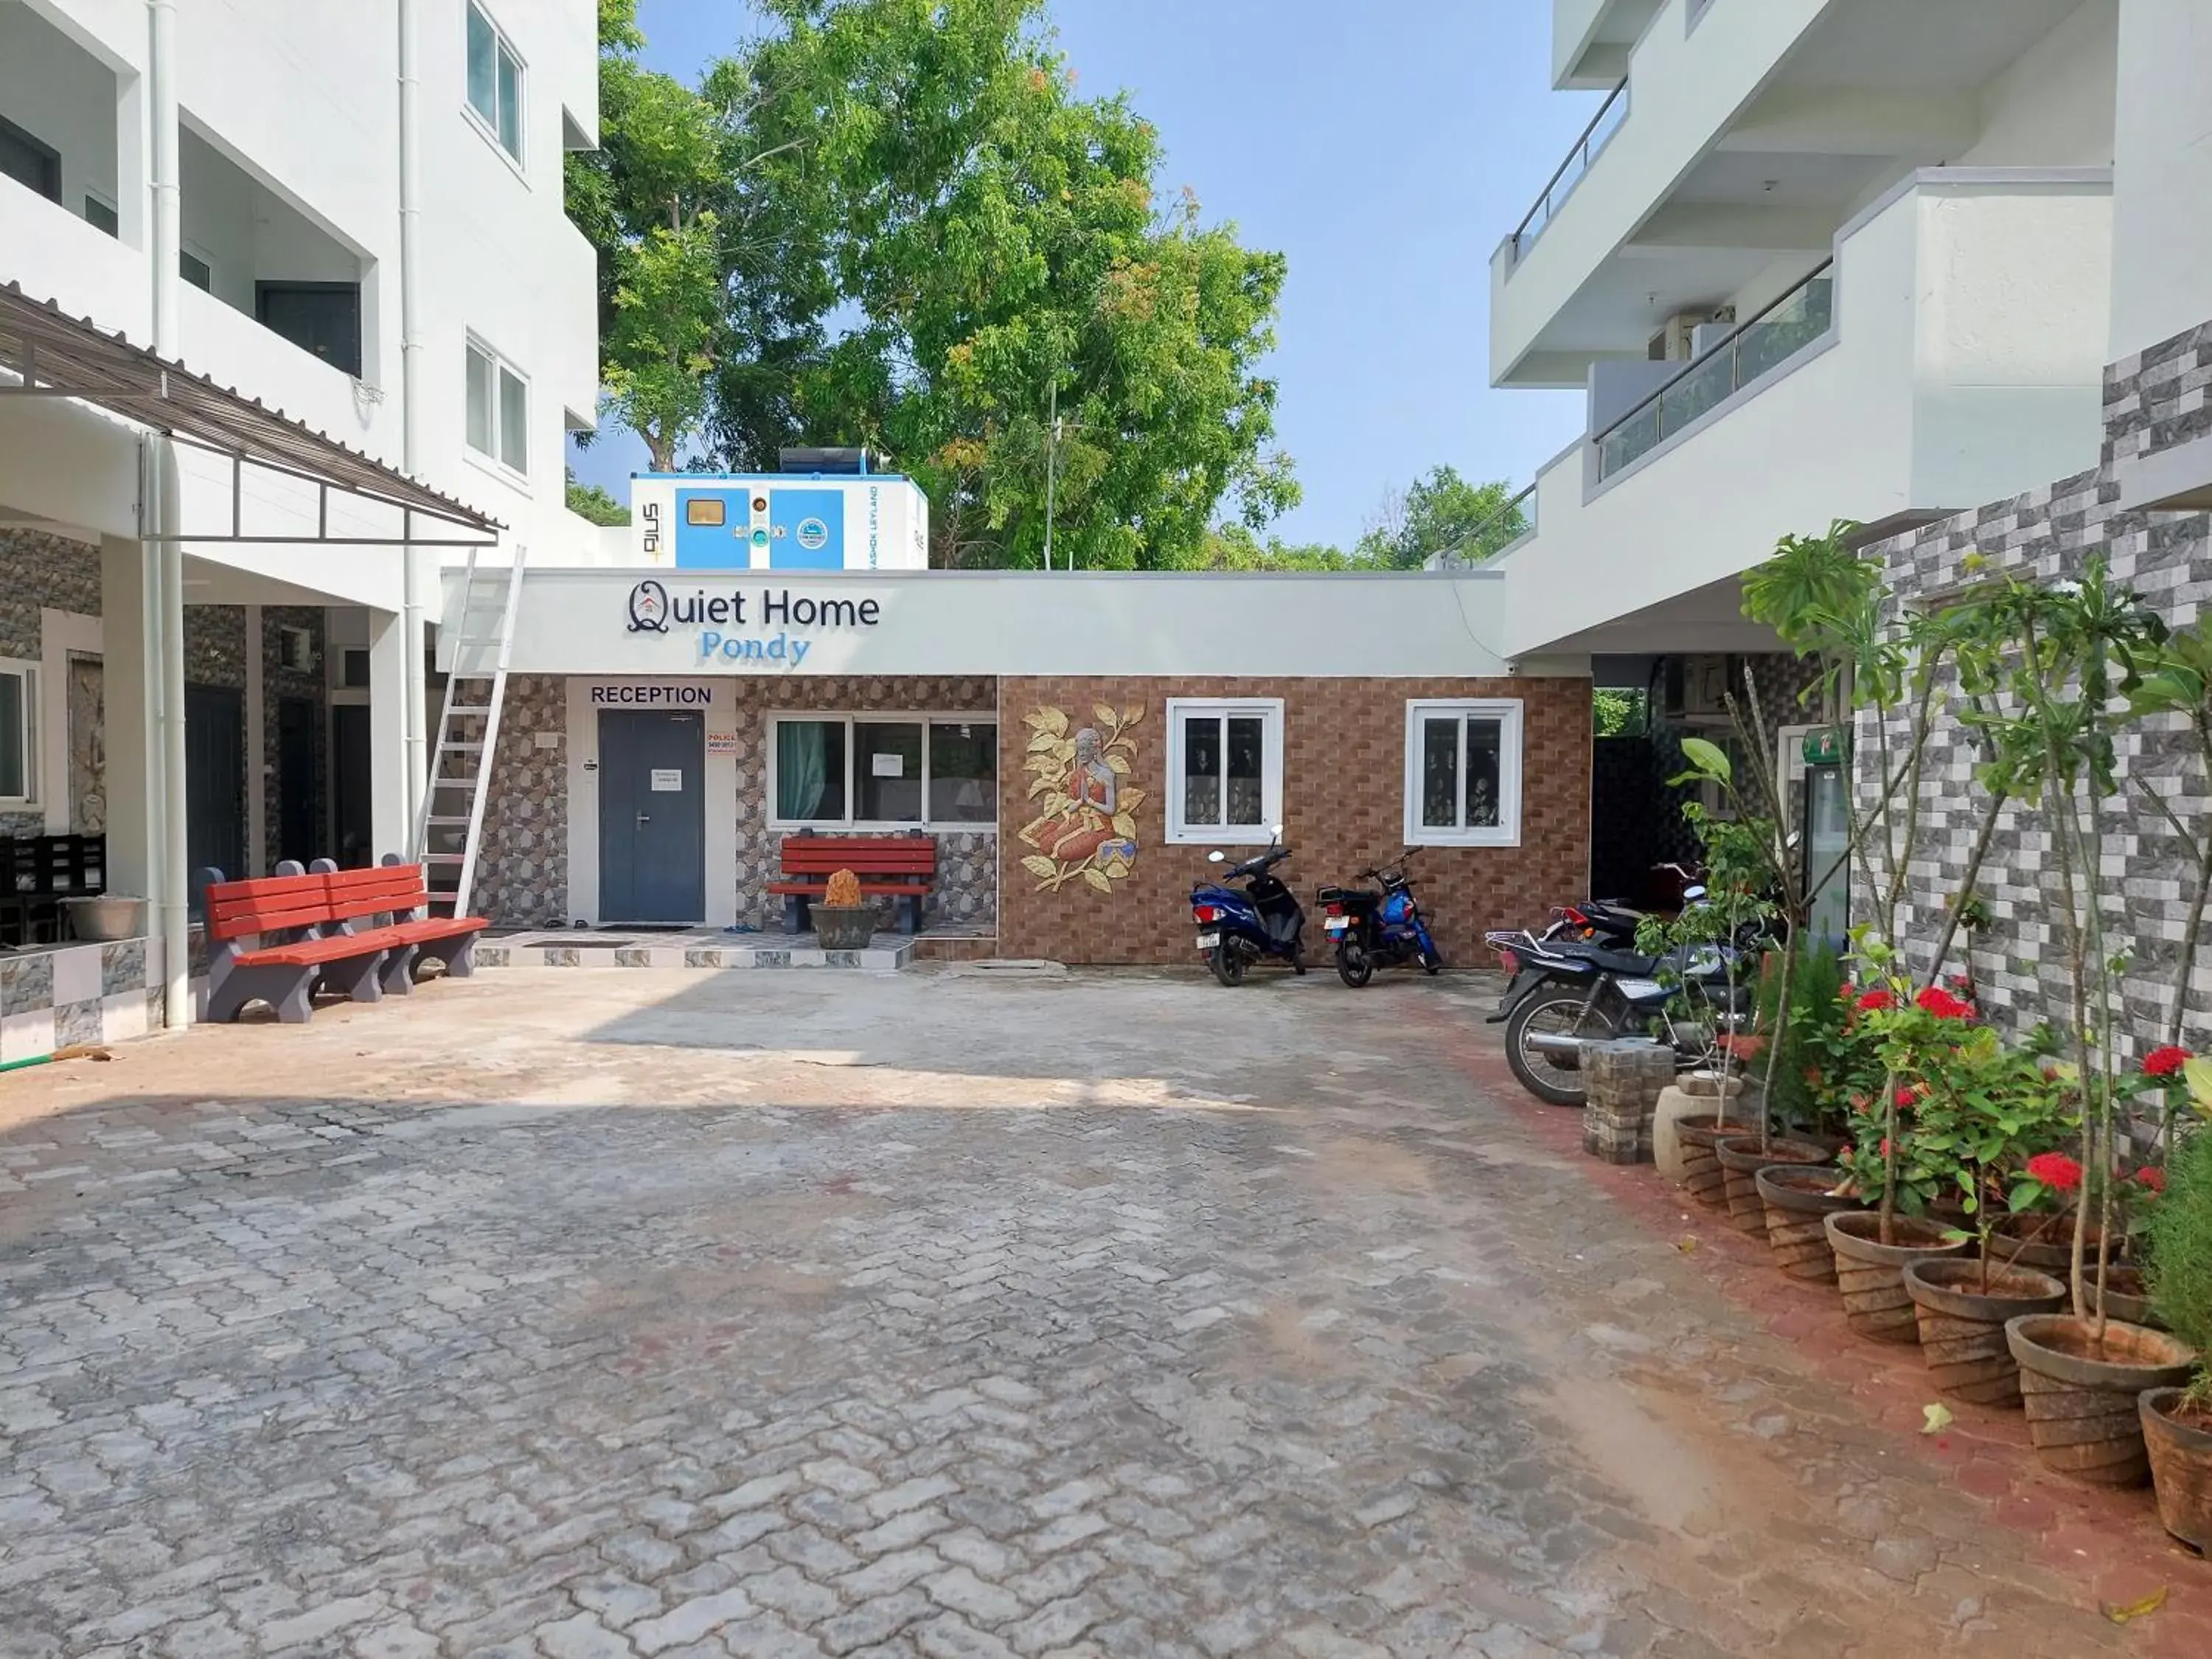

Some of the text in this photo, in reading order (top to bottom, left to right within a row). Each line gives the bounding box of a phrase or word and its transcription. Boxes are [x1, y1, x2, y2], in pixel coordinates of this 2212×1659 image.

[869, 486, 877, 566] ASHOK LEYLAND
[627, 580, 880, 633] Quiet Home
[700, 630, 812, 669] Pondy
[591, 686, 712, 703] RECEPTION
